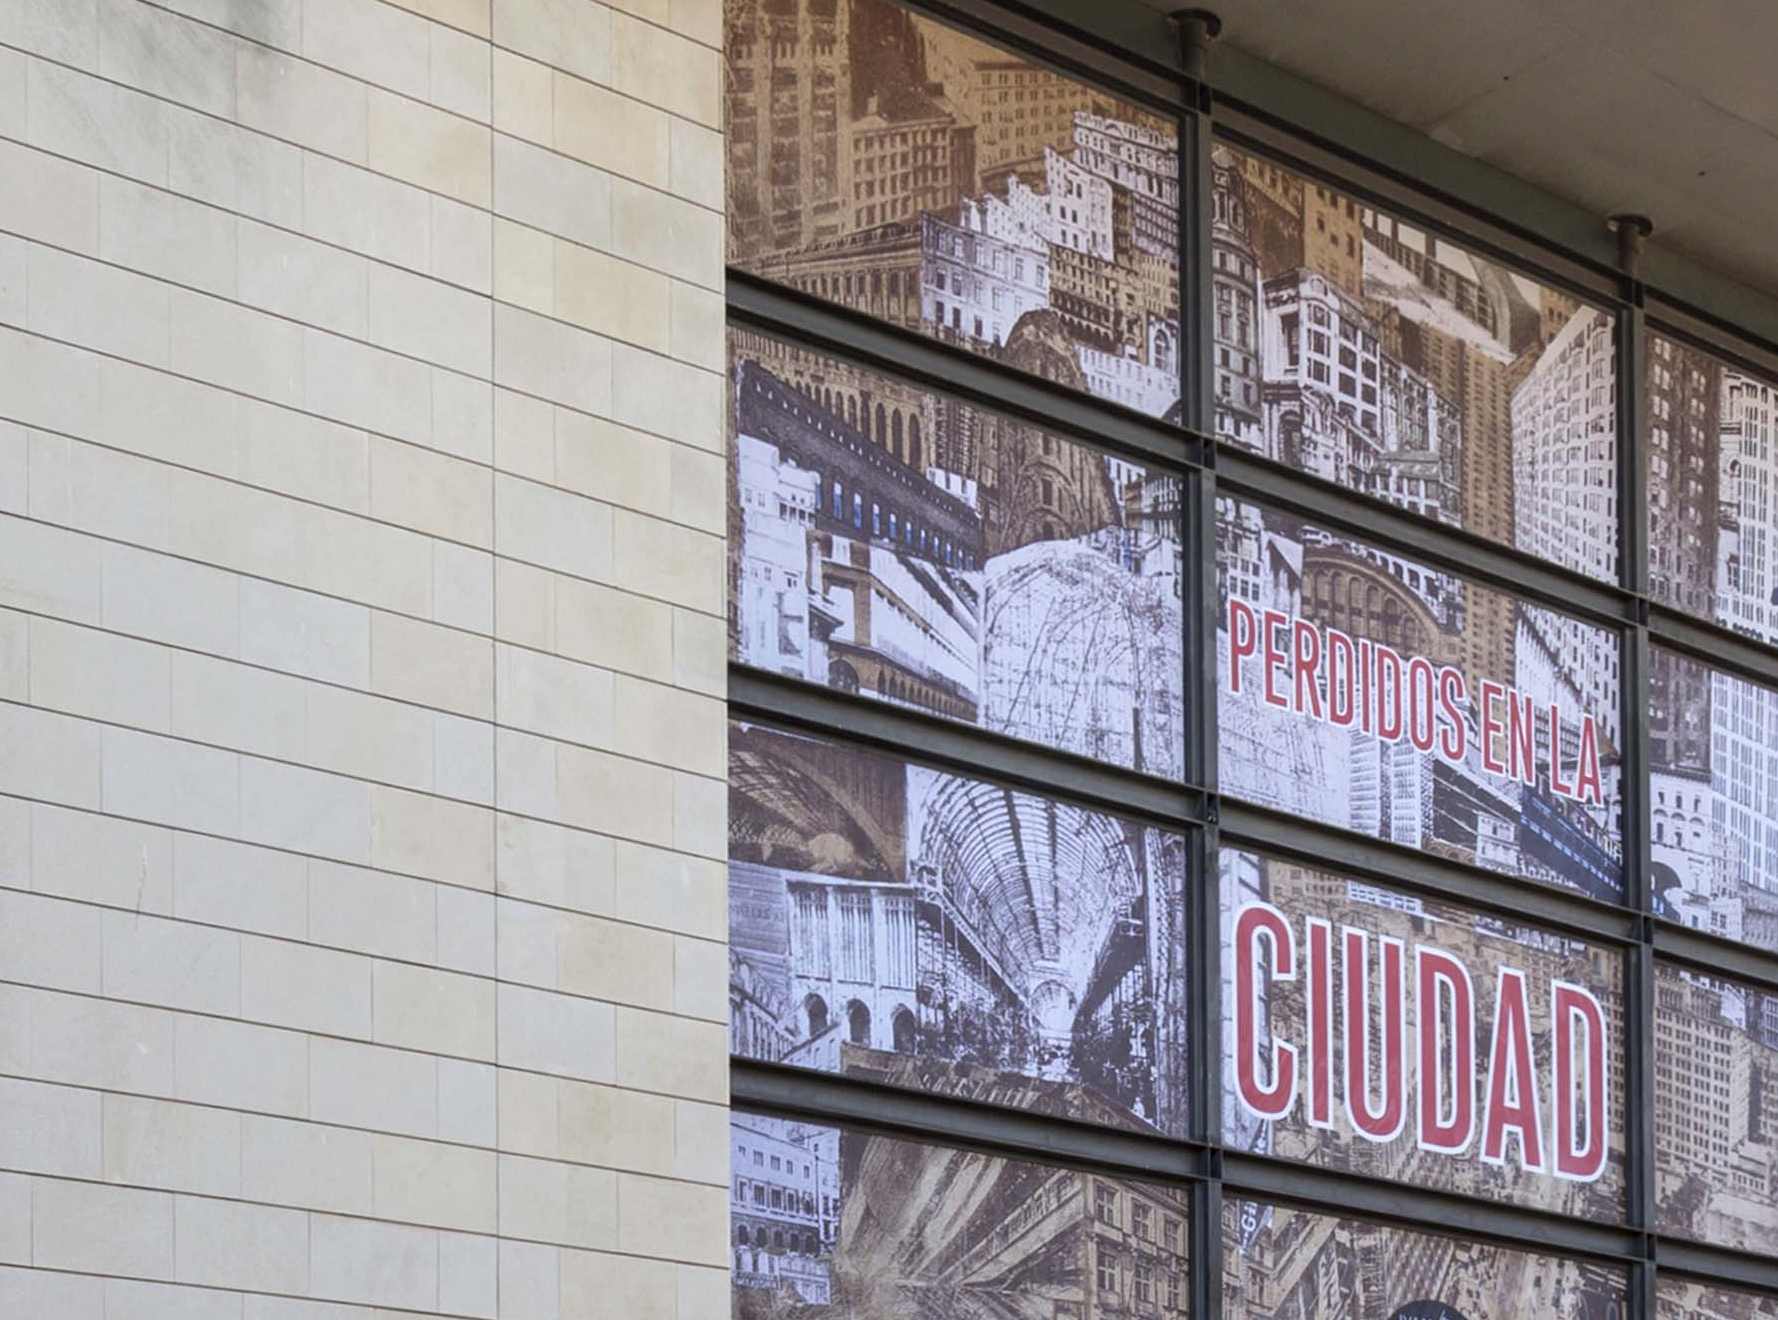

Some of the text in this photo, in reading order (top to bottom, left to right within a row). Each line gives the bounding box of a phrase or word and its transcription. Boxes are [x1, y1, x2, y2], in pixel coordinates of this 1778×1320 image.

[1228, 598, 1603, 808] PERDIDOS EN LA
[1233, 901, 1609, 1182] CIUDAD
